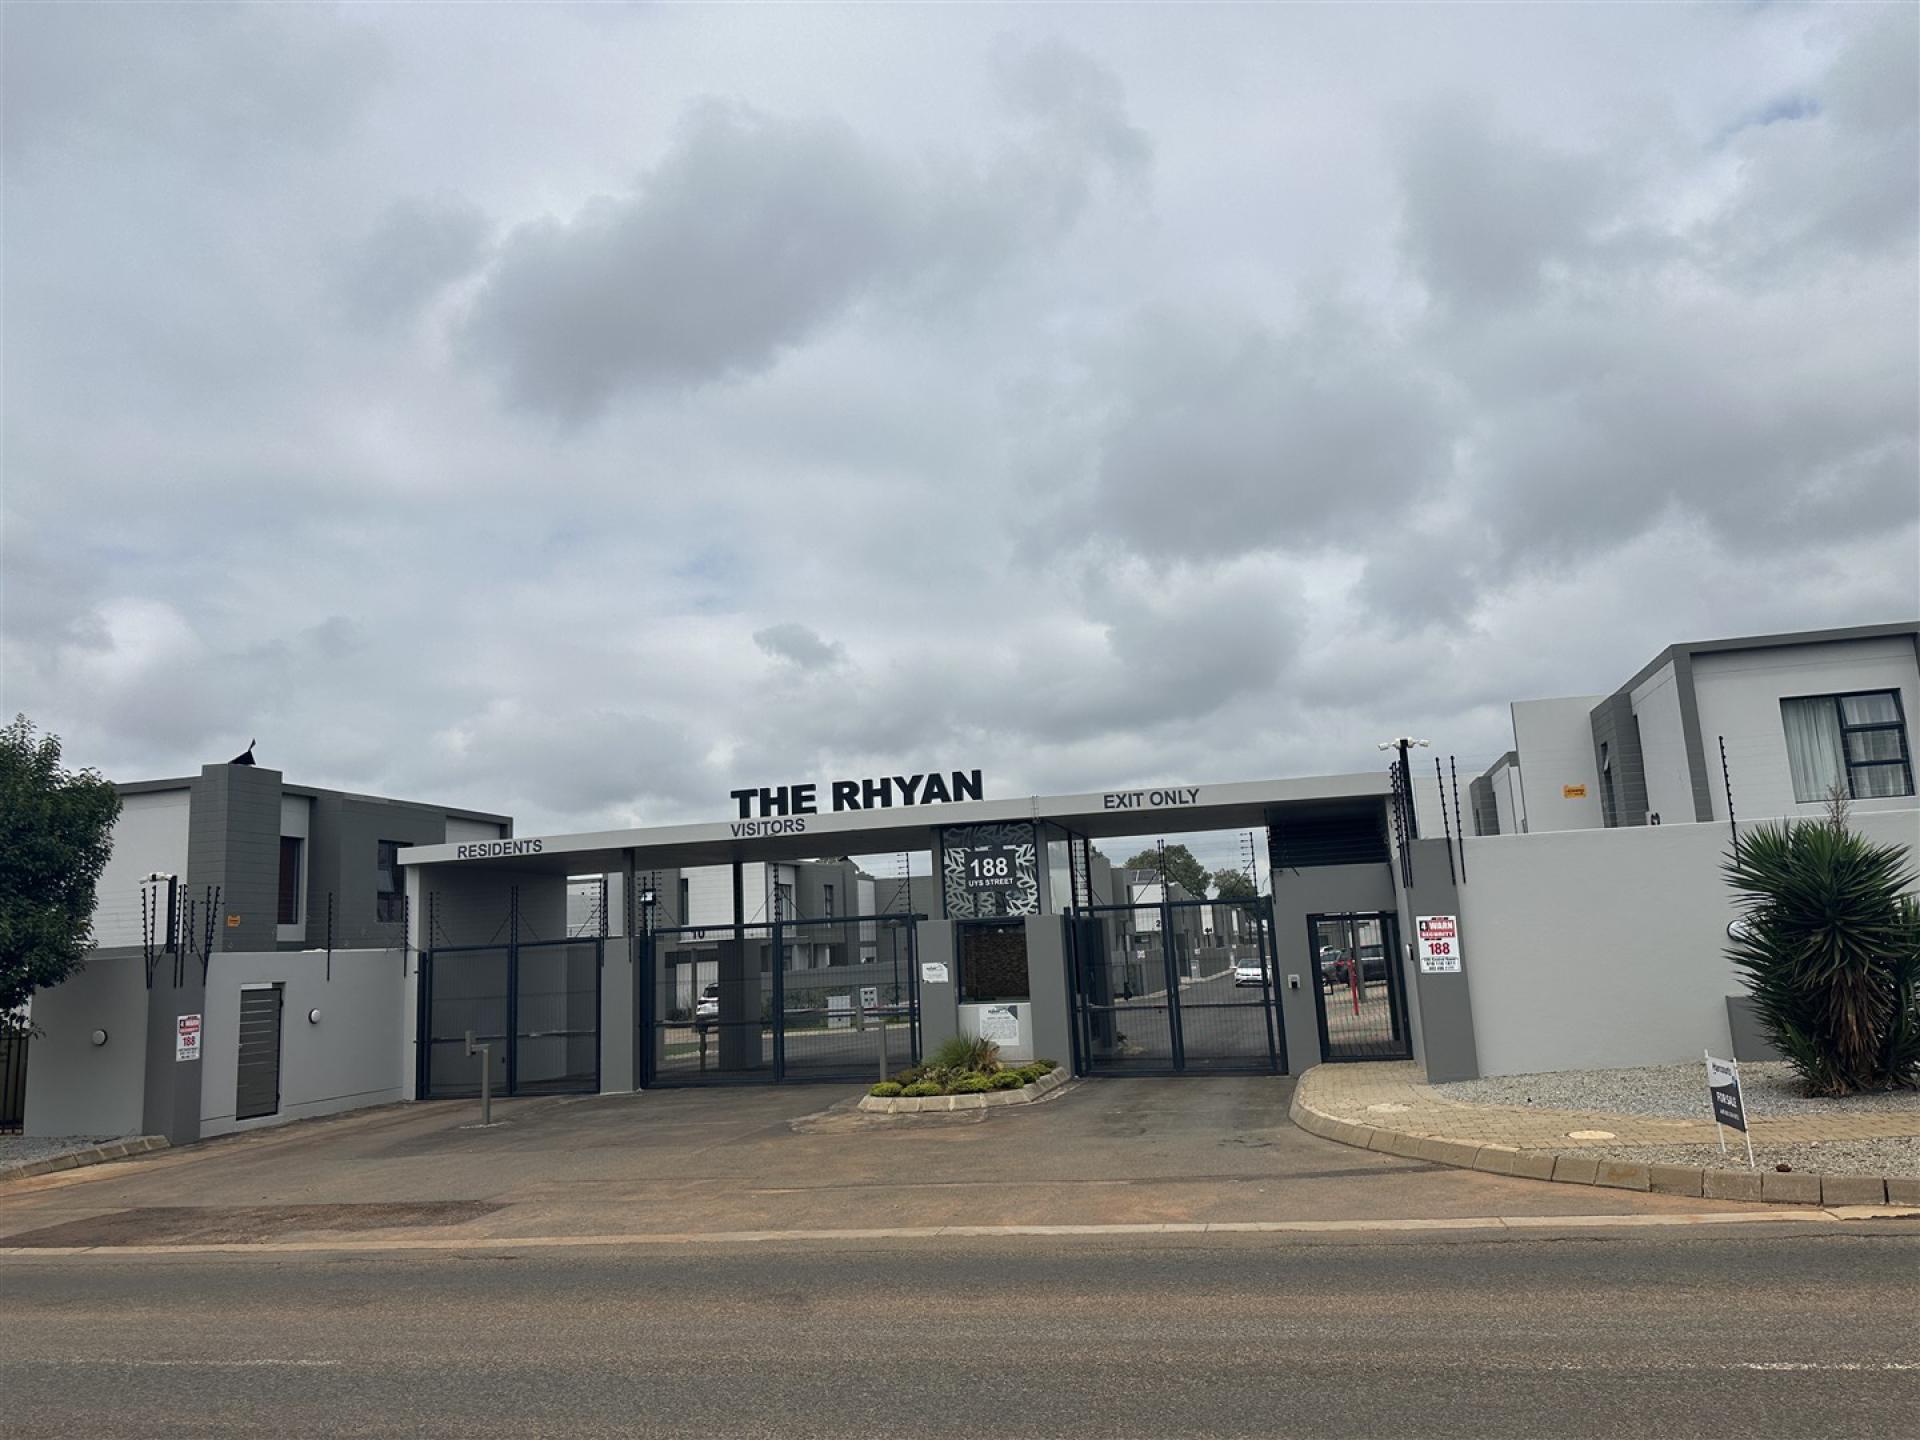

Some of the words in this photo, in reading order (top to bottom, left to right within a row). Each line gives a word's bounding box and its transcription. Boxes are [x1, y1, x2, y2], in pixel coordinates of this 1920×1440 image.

[730, 783, 817, 819] THE
[831, 769, 984, 812] RHYAN
[1103, 792, 1144, 809] EXIT
[1149, 788, 1200, 806] ONLY
[730, 818, 806, 837] VISITORS
[457, 839, 543, 858] RESIDENTS
[970, 857, 1008, 877] 188
[968, 879, 984, 887] UYS
[985, 877, 1013, 886] STREET
[1429, 921, 1454, 930] WARN
[1428, 942, 1451, 955] 188
[182, 1036, 196, 1047] 188
